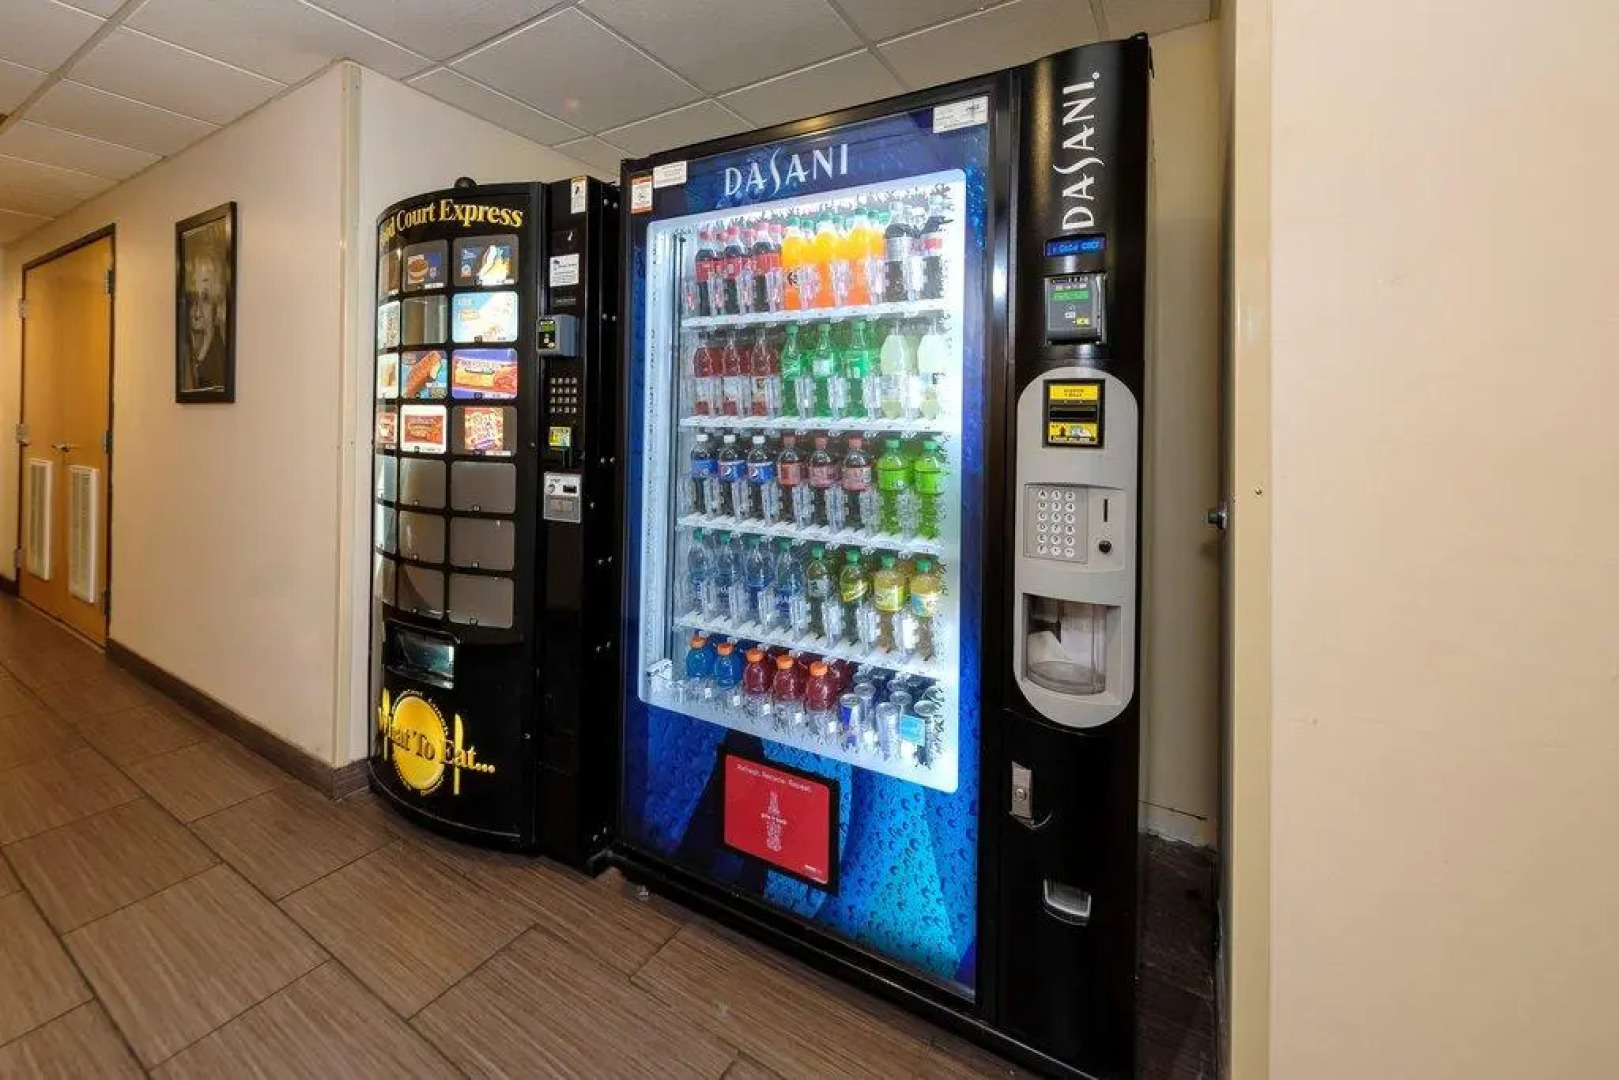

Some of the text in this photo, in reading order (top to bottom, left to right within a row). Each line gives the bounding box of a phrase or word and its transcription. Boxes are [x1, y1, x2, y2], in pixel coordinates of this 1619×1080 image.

[725, 144, 849, 196] DASANI
[396, 202, 436, 232] Court
[439, 198, 524, 228] Express
[412, 730, 436, 761] To
